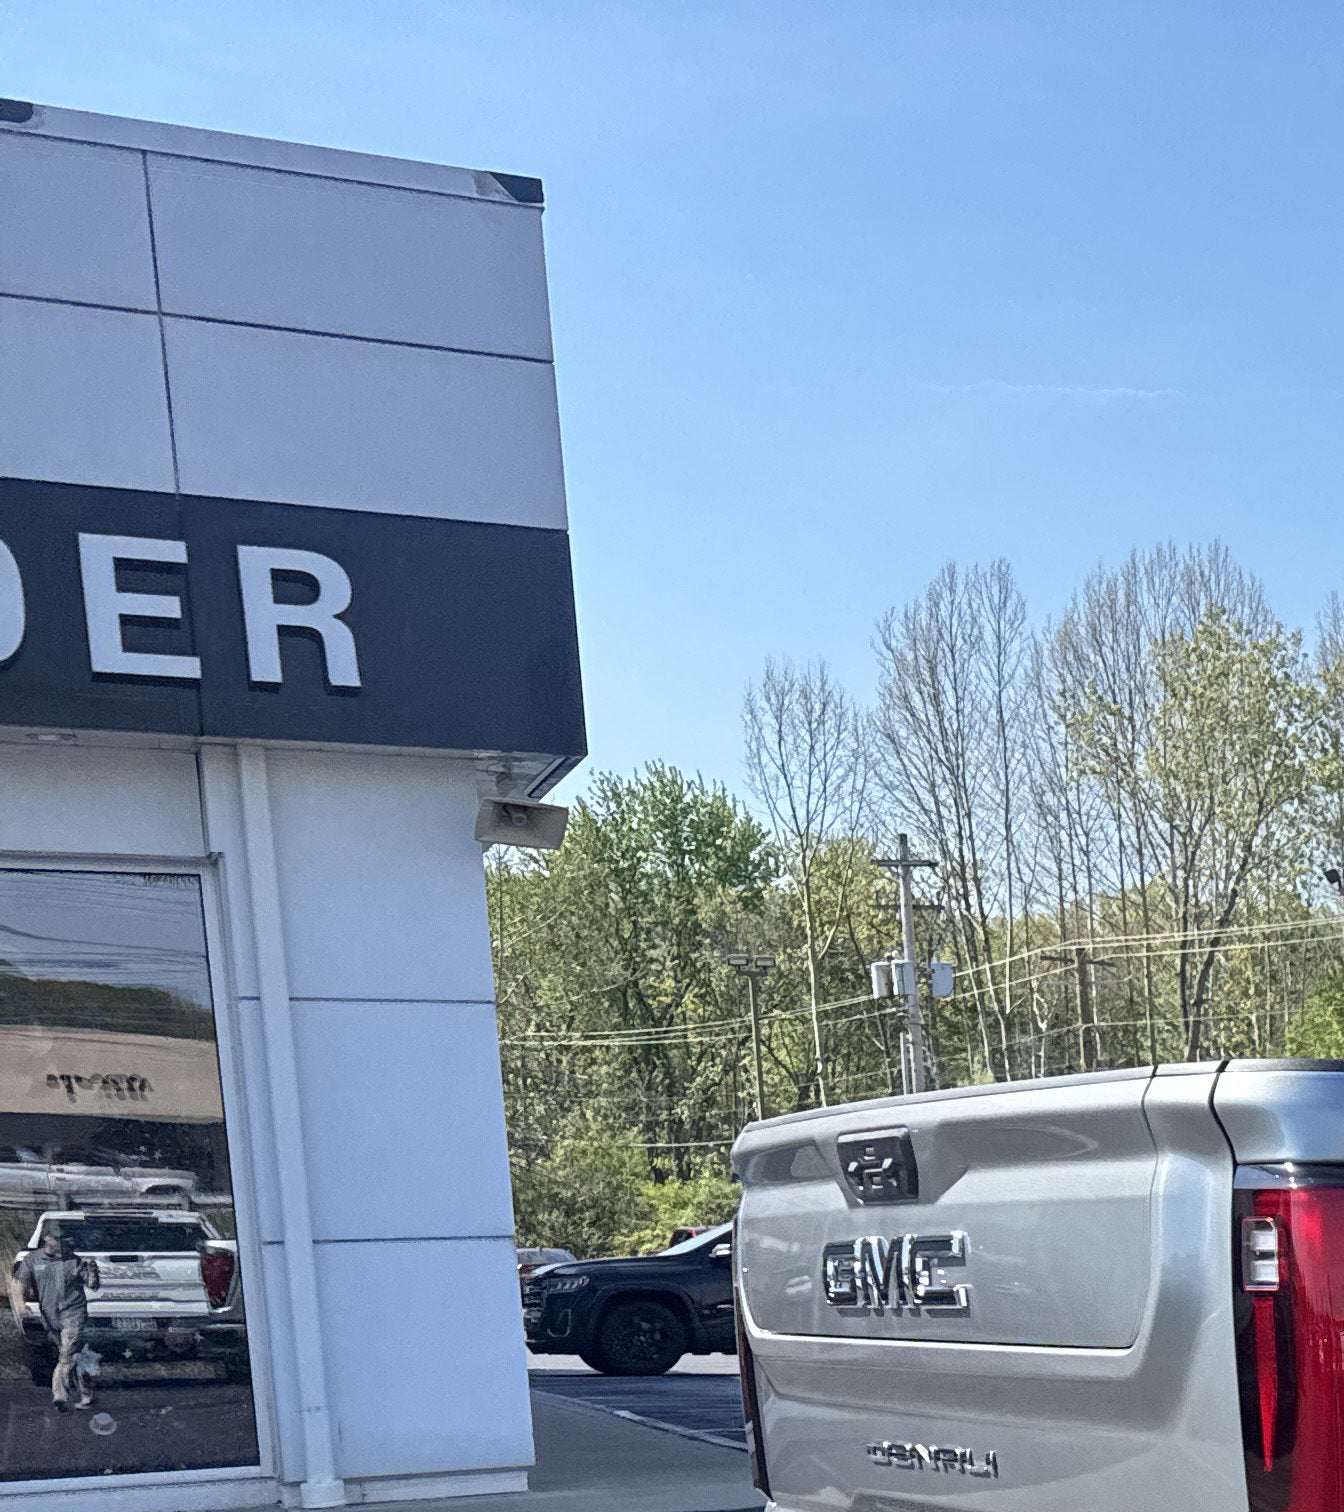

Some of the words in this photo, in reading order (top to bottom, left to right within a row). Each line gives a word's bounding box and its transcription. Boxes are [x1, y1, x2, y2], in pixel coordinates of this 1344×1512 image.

[0, 532, 363, 688] ER
[822, 1230, 974, 1312] GMC
[866, 1440, 999, 1480] DENALI
